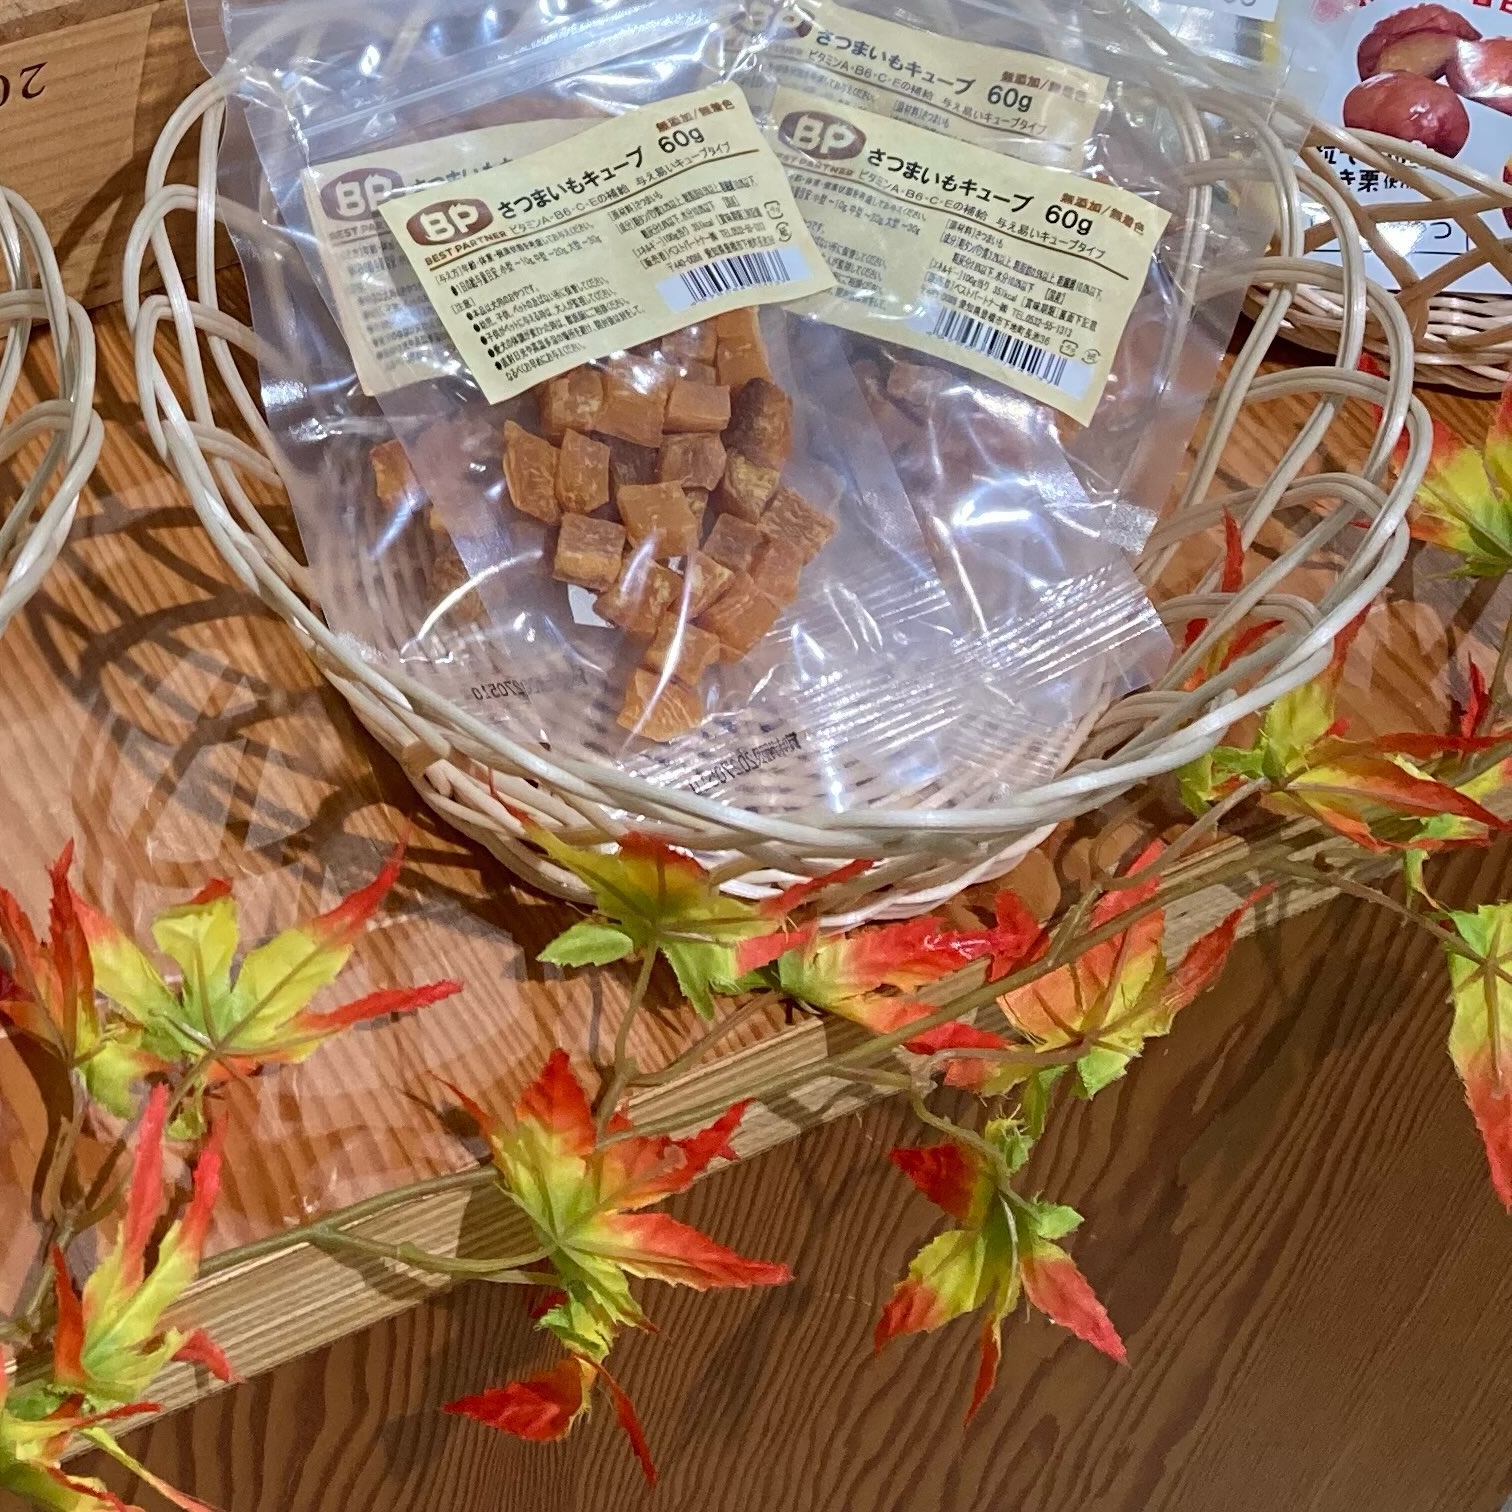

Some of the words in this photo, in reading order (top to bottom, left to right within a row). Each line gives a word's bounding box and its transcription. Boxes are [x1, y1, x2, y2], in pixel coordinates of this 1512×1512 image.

[816, 29, 976, 96] さつまいもキューブ
[987, 85, 1034, 114] 60g
[655, 98, 736, 134] 無添加/無着色
[792, 114, 858, 154] BP
[941, 96, 1048, 135] 与え易いキューブタイプ
[497, 144, 644, 220] さつまいもキューブ
[657, 125, 705, 154] 60g
[635, 141, 731, 188] 与え易いキューブタイプ
[865, 147, 1034, 213] さつまいもキューブ
[1044, 203, 1094, 236] 60g
[419, 201, 480, 242] BP
[1059, 192, 1146, 236] 無添加/無着色
[423, 249, 454, 267] BEST
[454, 229, 508, 255] PARTNER
[995, 217, 1106, 260] 与え易いキューブタイプ
